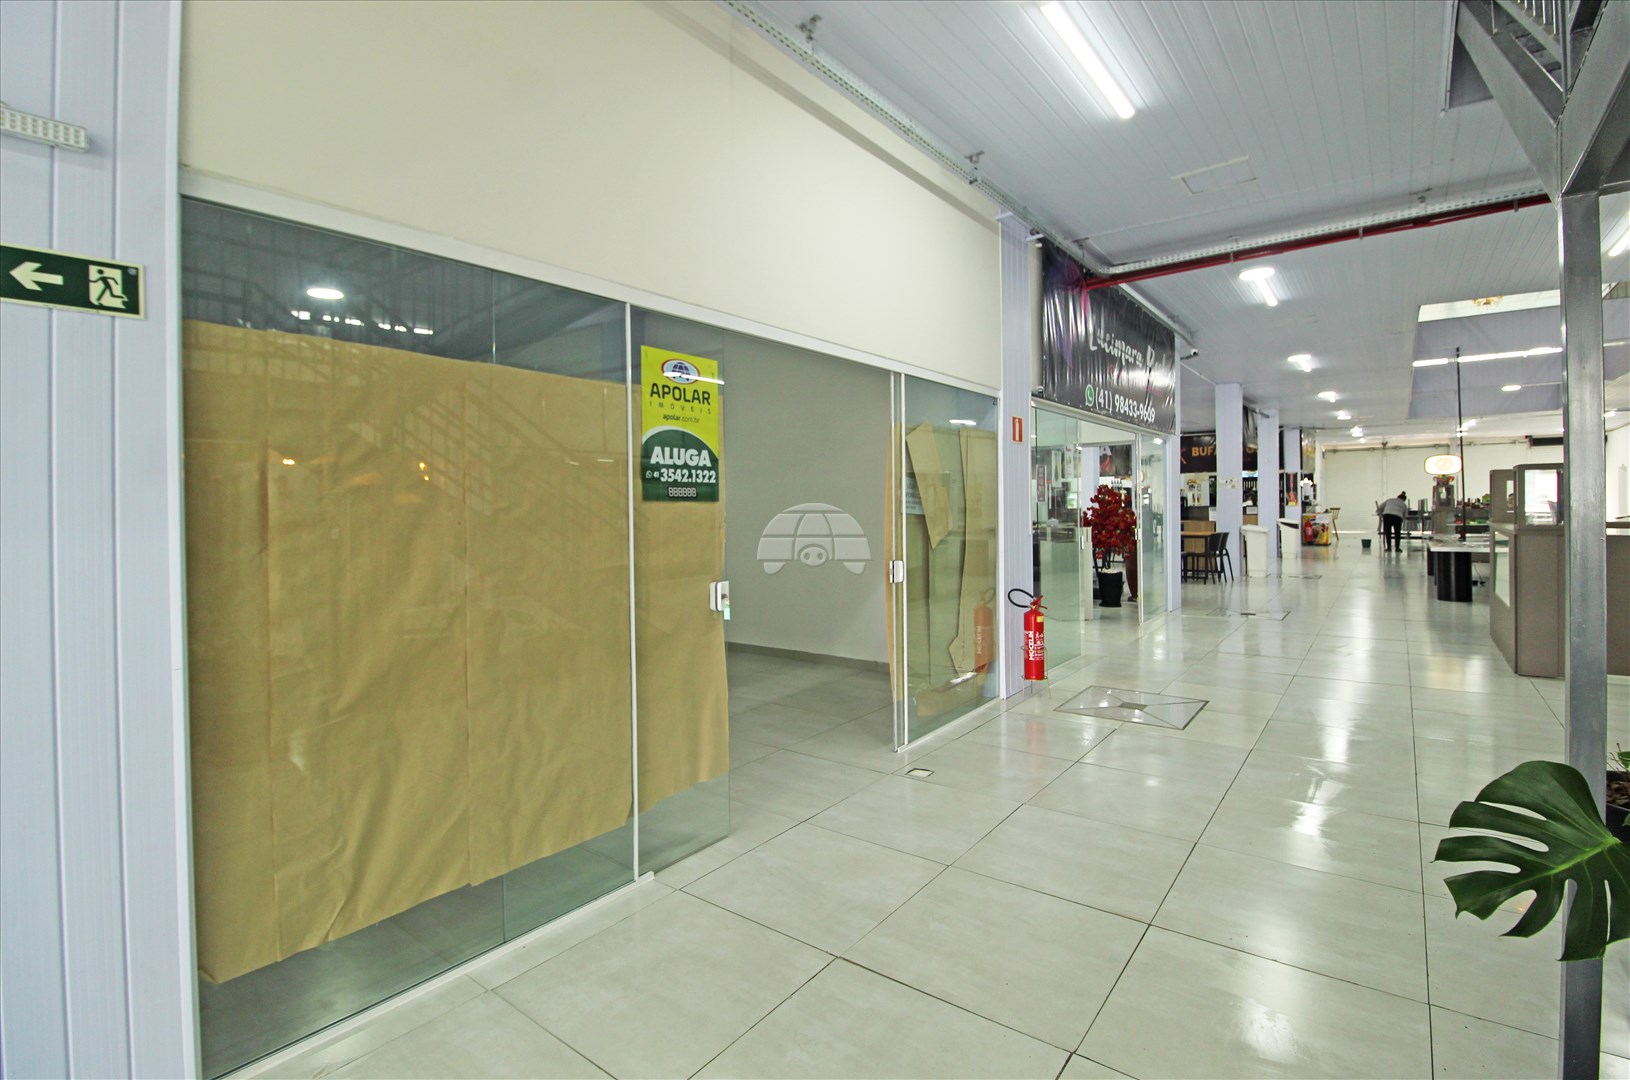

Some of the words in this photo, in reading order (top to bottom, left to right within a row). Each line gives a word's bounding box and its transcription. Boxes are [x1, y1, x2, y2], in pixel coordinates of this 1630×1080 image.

[650, 383, 711, 406] APOLAR
[1095, 386, 1113, 414] (41)
[662, 413, 700, 424] apolar.com.br
[650, 446, 712, 467] ALUGA
[1191, 446, 1217, 457] BUF
[660, 468, 716, 483] 3542.1322
